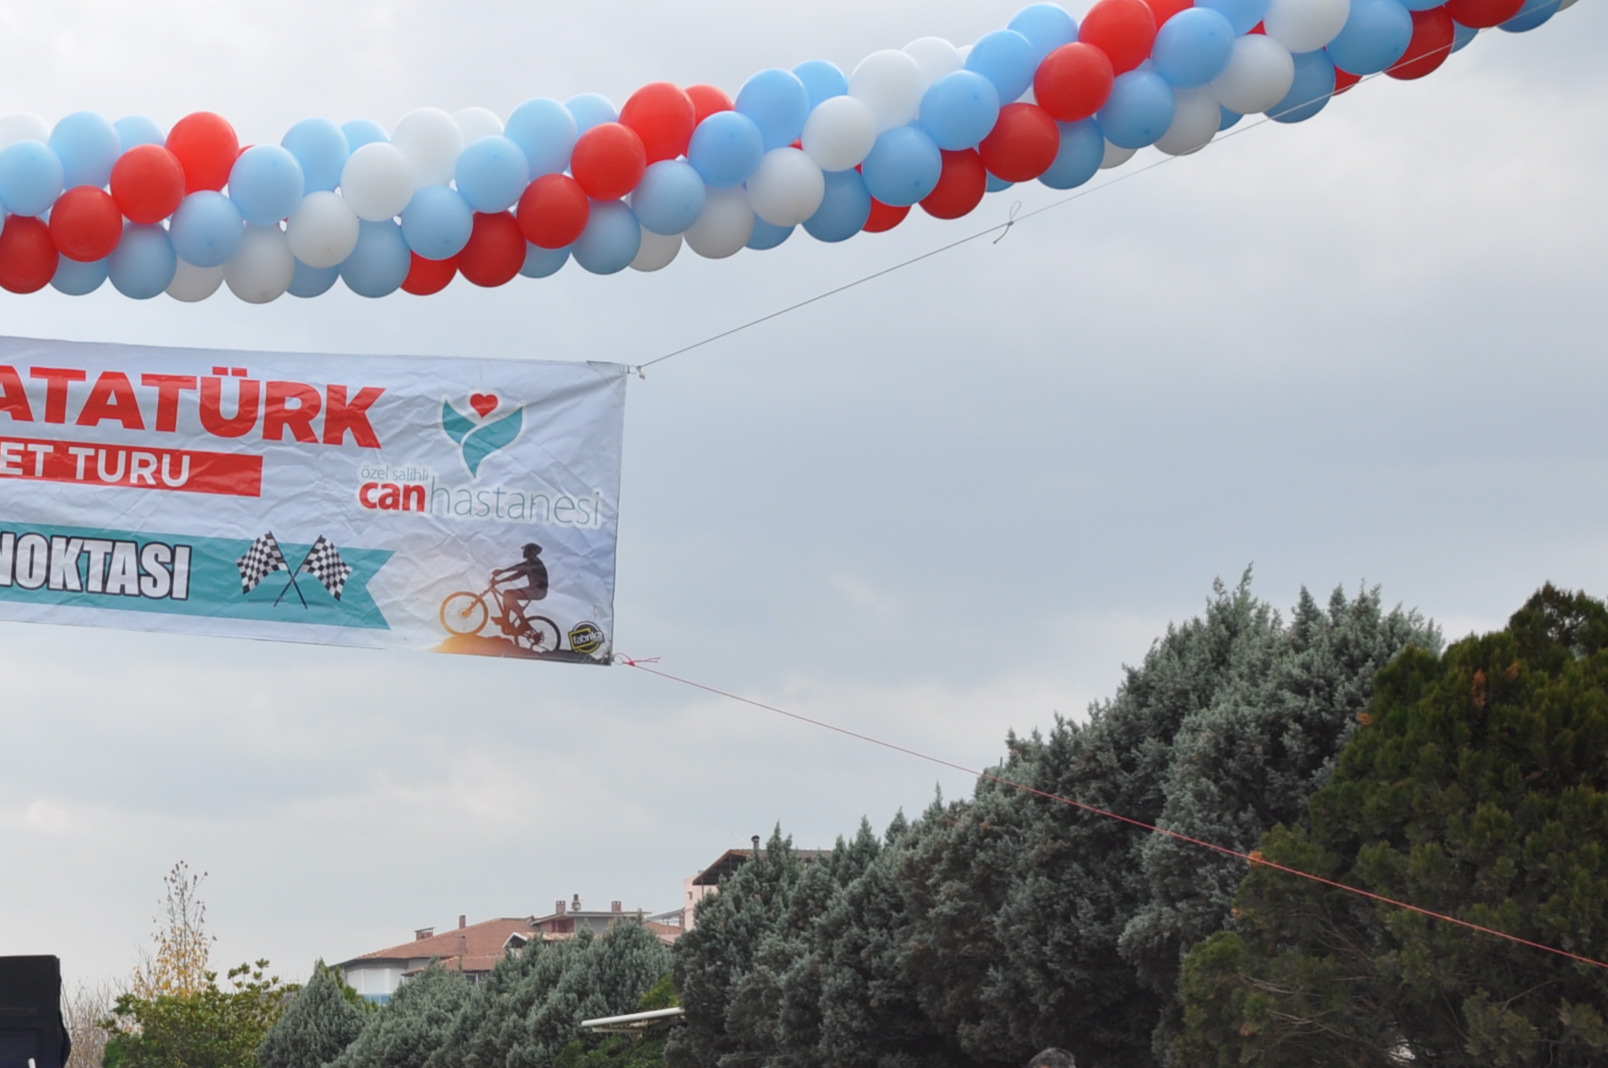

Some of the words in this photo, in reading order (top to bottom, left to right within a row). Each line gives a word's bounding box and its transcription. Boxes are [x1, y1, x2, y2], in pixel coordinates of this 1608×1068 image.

[68, 446, 191, 487] TURU
[361, 465, 389, 480] özel
[392, 466, 429, 482] salihli
